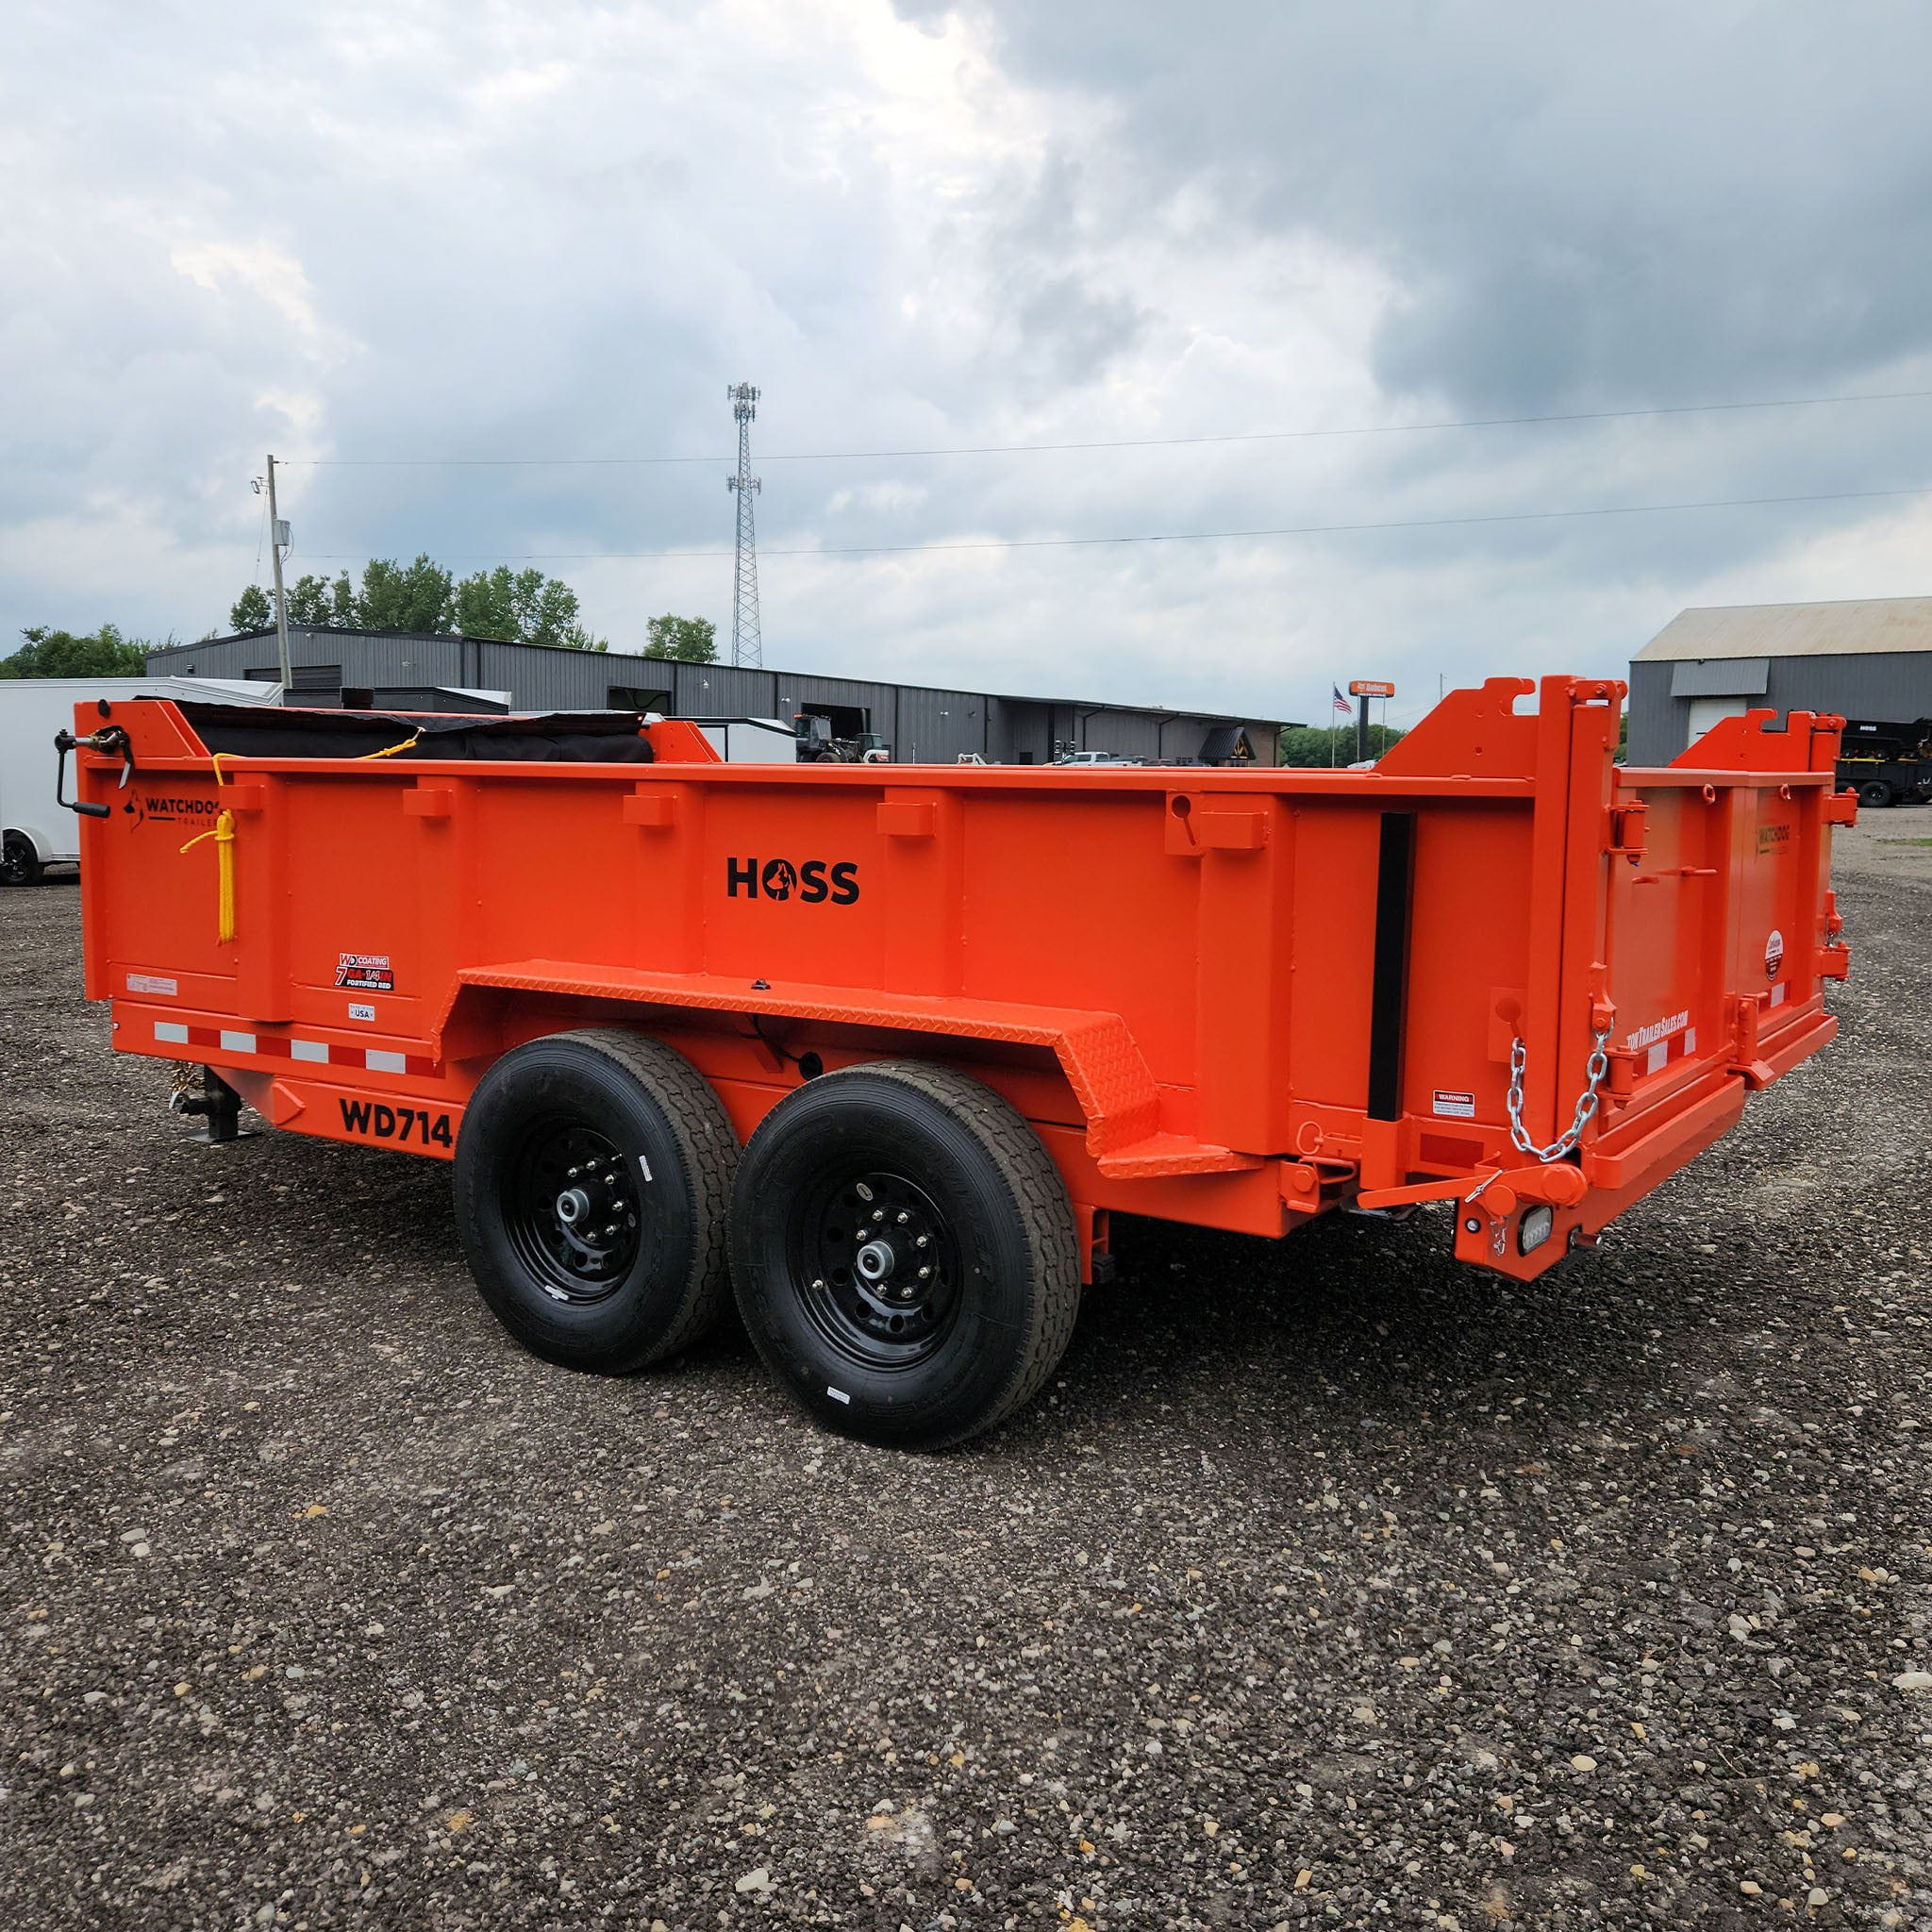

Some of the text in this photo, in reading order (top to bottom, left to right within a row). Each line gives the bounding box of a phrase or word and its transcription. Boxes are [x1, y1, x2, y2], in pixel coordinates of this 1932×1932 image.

[727, 857, 859, 906] HOSS
[358, 957, 387, 966] COATING
[335, 966, 348, 986] 7
[355, 1009, 369, 1018] USA
[1439, 1093, 1470, 1103] WARNING
[339, 1098, 453, 1148] WD714
